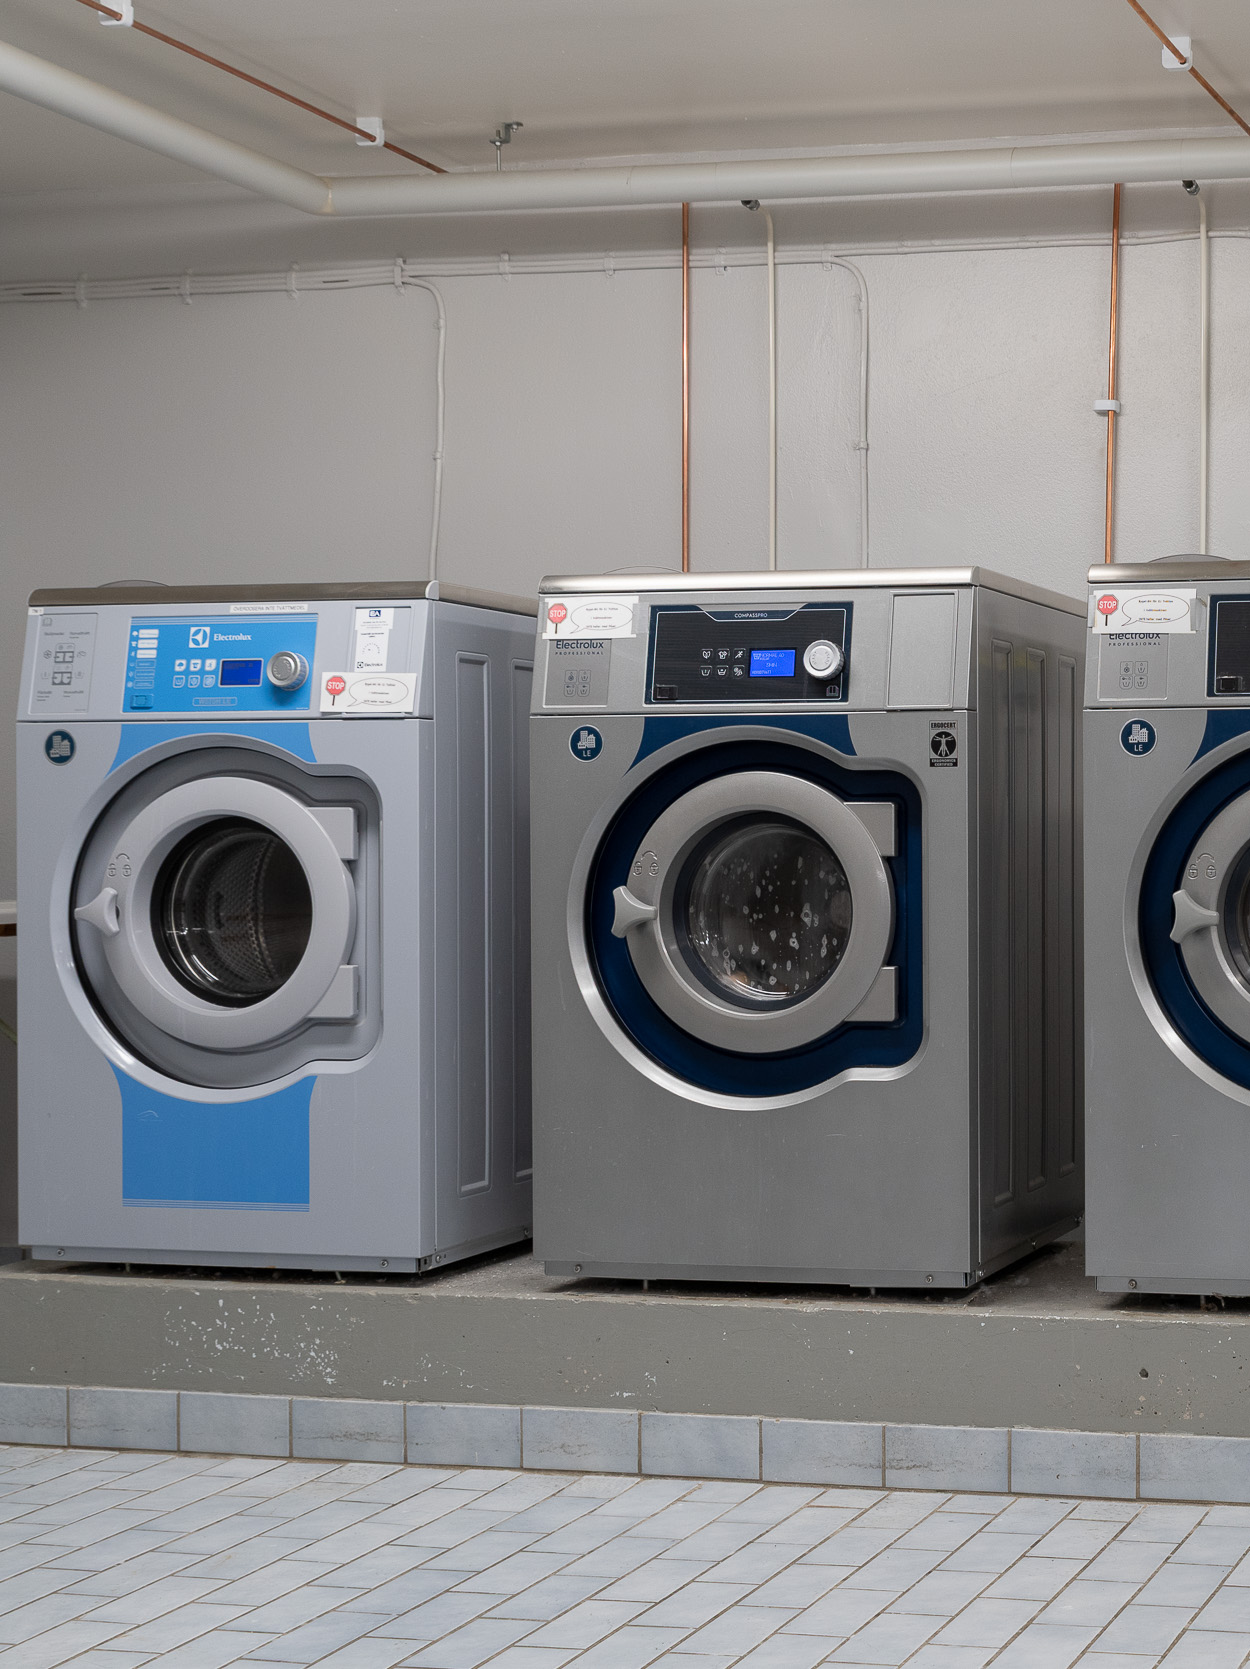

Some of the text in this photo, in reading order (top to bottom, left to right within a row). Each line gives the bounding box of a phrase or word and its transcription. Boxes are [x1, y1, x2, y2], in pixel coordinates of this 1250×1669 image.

[1098, 601, 1117, 609] STOP
[549, 609, 567, 618] STOP
[213, 632, 252, 642] Electrolux
[555, 640, 604, 650] Electrolux
[327, 681, 345, 690] STOP
[1133, 744, 1143, 752] LE
